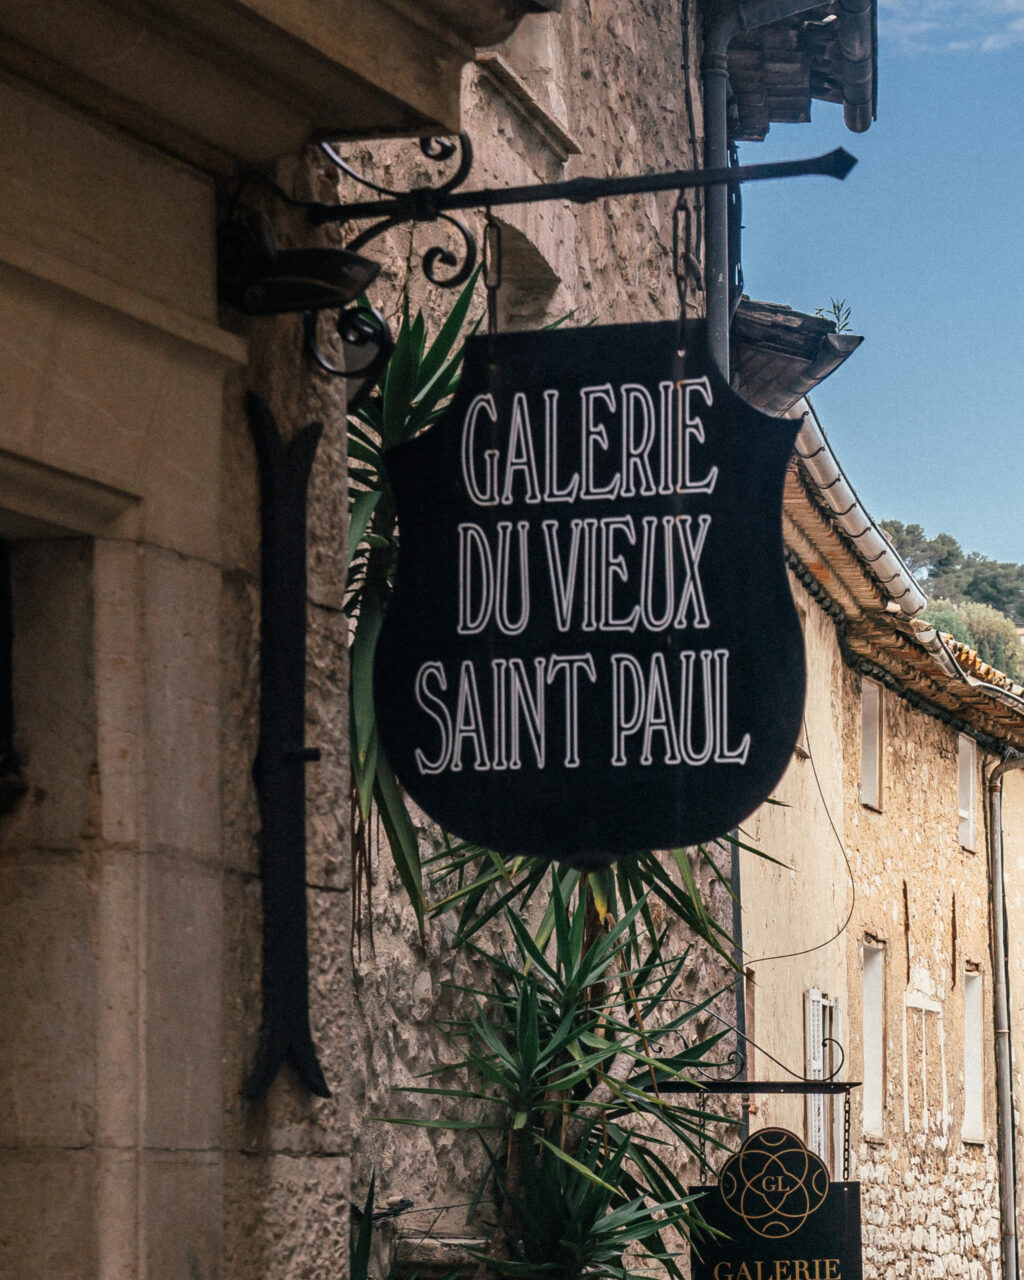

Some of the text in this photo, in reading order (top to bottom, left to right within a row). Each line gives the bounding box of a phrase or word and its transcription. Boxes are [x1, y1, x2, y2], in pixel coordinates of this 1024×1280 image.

[461, 376, 718, 506] GALERIE
[457, 514, 712, 636] DU VIEUX
[414, 648, 751, 775] SAINT PAUL
[761, 1175, 790, 1193] GL
